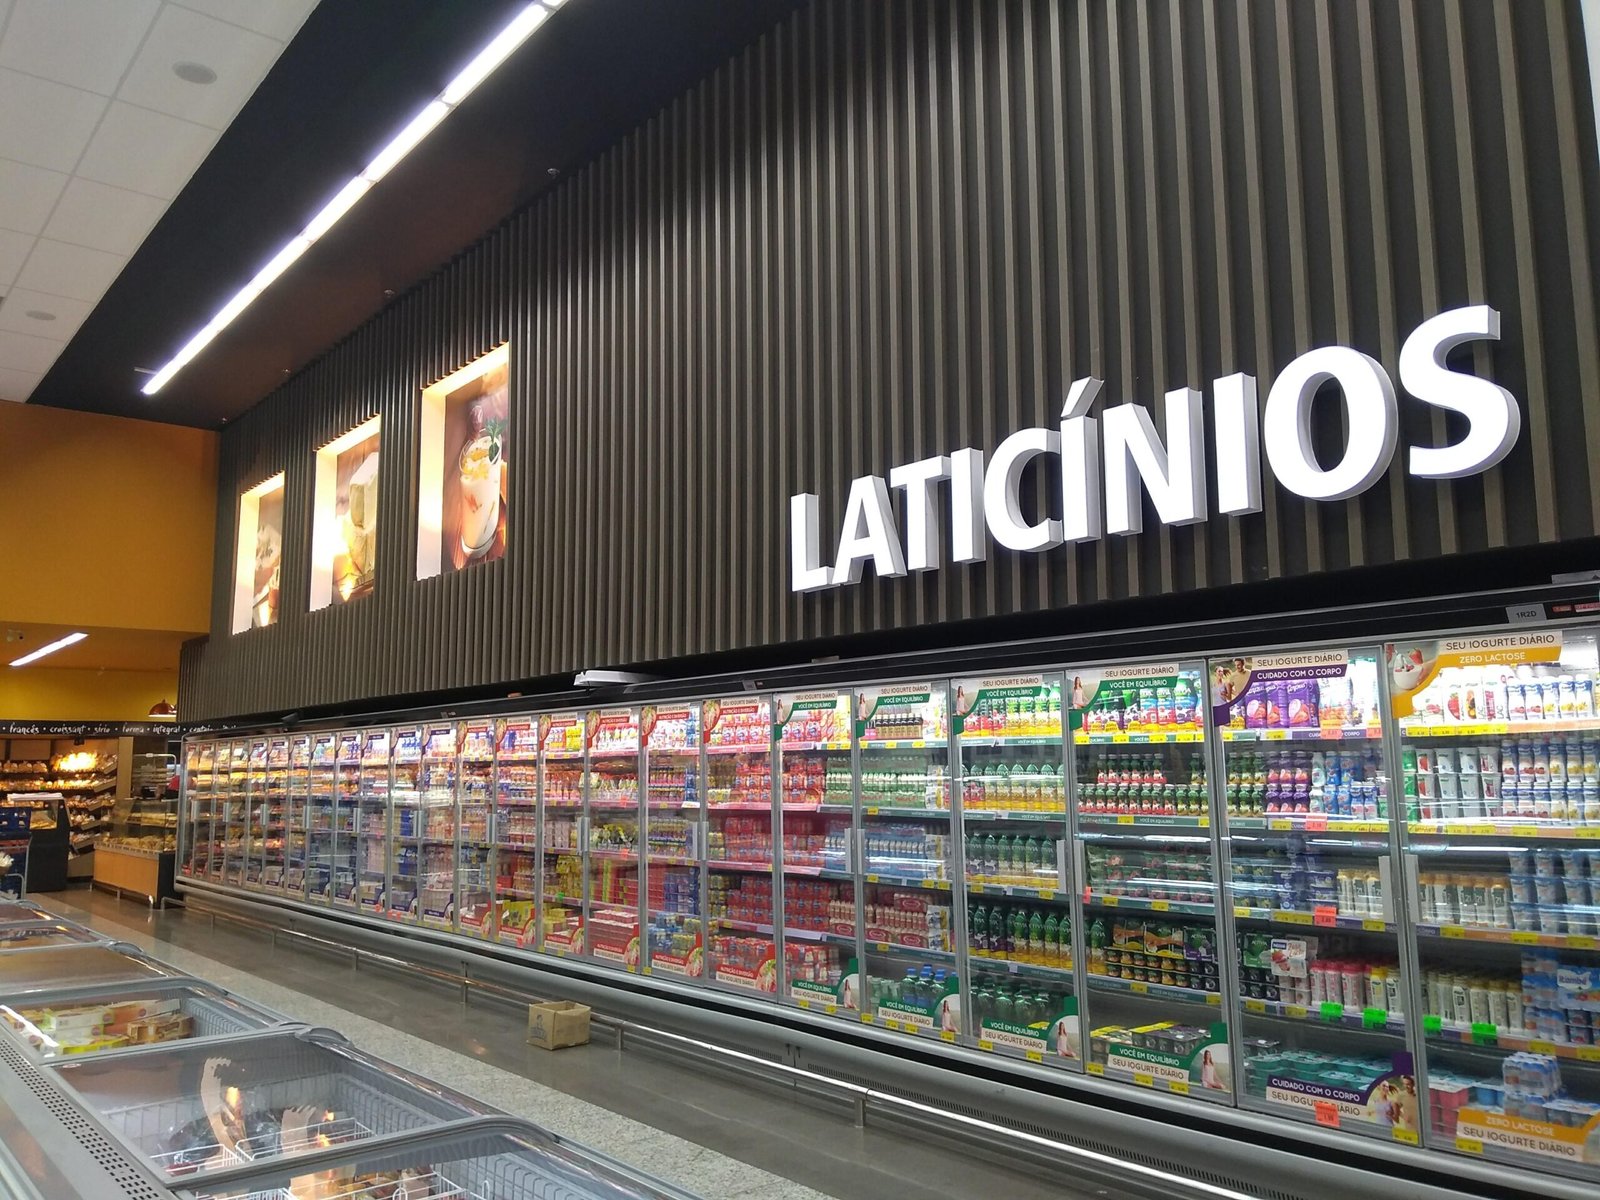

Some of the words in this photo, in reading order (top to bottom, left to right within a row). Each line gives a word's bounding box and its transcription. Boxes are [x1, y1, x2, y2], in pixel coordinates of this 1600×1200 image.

[791, 304, 1522, 593] LATICÍNIOS
[1516, 610, 1537, 619] 1R2D
[1446, 641, 1466, 651] SEU
[1469, 637, 1517, 649] IOGURTE
[1519, 633, 1555, 646] DIÁRIO
[1257, 658, 1274, 667] SEU
[1275, 656, 1313, 666] IOGURTE
[1314, 652, 1343, 663] DIÁRIO
[1459, 654, 1483, 664] ZERO
[1485, 651, 1527, 662] LACTOSE
[1104, 669, 1118, 679] SEU
[1118, 667, 1150, 678] IOGURTE
[1150, 665, 1175, 676] DIÁRIO
[1257, 671, 1288, 681] CUIDADO
[1289, 670, 1306, 679] COM
[1316, 667, 1343, 677] CORPO
[890, 686, 912, 694] IOGURTE
[912, 684, 928, 692] DIÁRIO
[982, 679, 994, 687] SEU
[994, 677, 1019, 686] IOGURTE
[1020, 675, 1039, 685] DIÁRIO
[1109, 679, 1125, 689] VOCÊ
[1135, 678, 1168, 689] EQUILÍBRIO
[986, 689, 998, 697] VOCÊ
[1006, 688, 1034, 697] EQUILÍBRIO
[881, 1009, 891, 1017] SEU
[891, 1012, 913, 1022] IOGURTE
[913, 1016, 931, 1026] DIÁRIO
[990, 1021, 1004, 1030] VOCÊ
[1012, 1026, 1040, 1038] EQUILÍBRIO
[984, 1030, 996, 1040] SEU
[996, 1033, 1022, 1046] IOGURTE
[1022, 1037, 1044, 1050] DIÁRIO
[1119, 1047, 1136, 1057] VOCÊ
[1146, 1052, 1181, 1067] EQUILÍBRIO
[1112, 1058, 1127, 1068] SEU
[1127, 1060, 1160, 1075] IOGURTE
[1160, 1065, 1184, 1080] DIÁRIO
[1271, 1078, 1305, 1092] CUIDADO
[1306, 1085, 1324, 1095] COM
[1324, 1088, 1332, 1096] O
[1333, 1090, 1361, 1102] CORPO
[1271, 1090, 1289, 1101] SEU
[1485, 1116, 1511, 1128] ZERO
[1511, 1120, 1555, 1137] LACTOSE
[1463, 1126, 1484, 1139] SEU
[1487, 1130, 1537, 1149] IOGURTE
[1538, 1141, 1577, 1157] DIÁRIO
